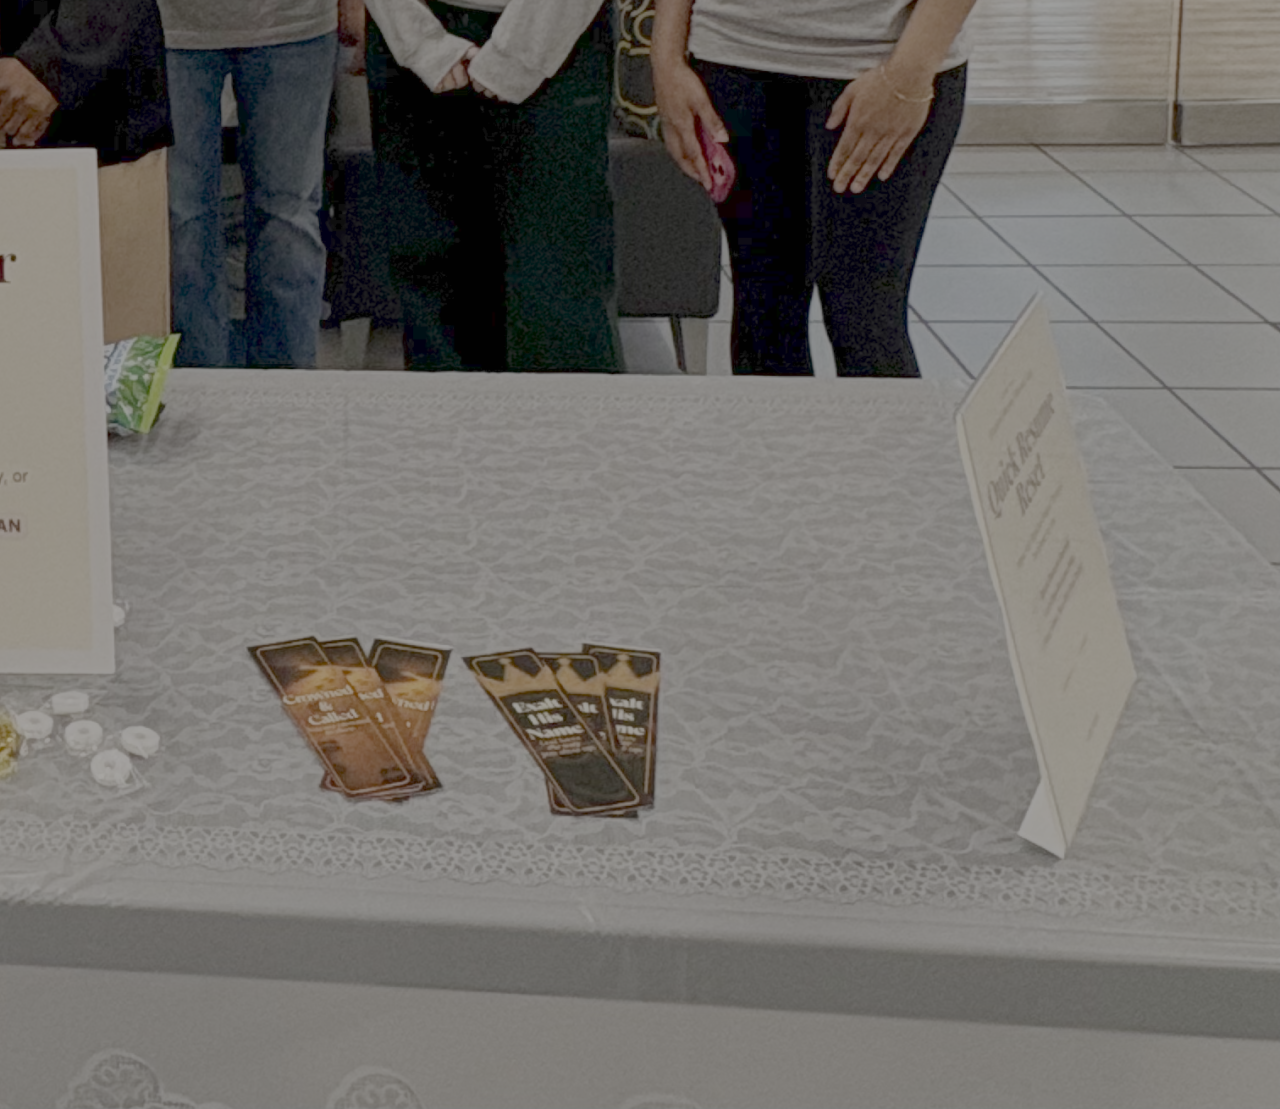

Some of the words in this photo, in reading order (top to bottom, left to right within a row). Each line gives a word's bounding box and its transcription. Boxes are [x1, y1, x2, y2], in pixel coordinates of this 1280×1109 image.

[12, 471, 29, 483] or
[511, 697, 564, 715] Exalt
[307, 708, 360, 727] Called
[524, 723, 586, 742] Name
